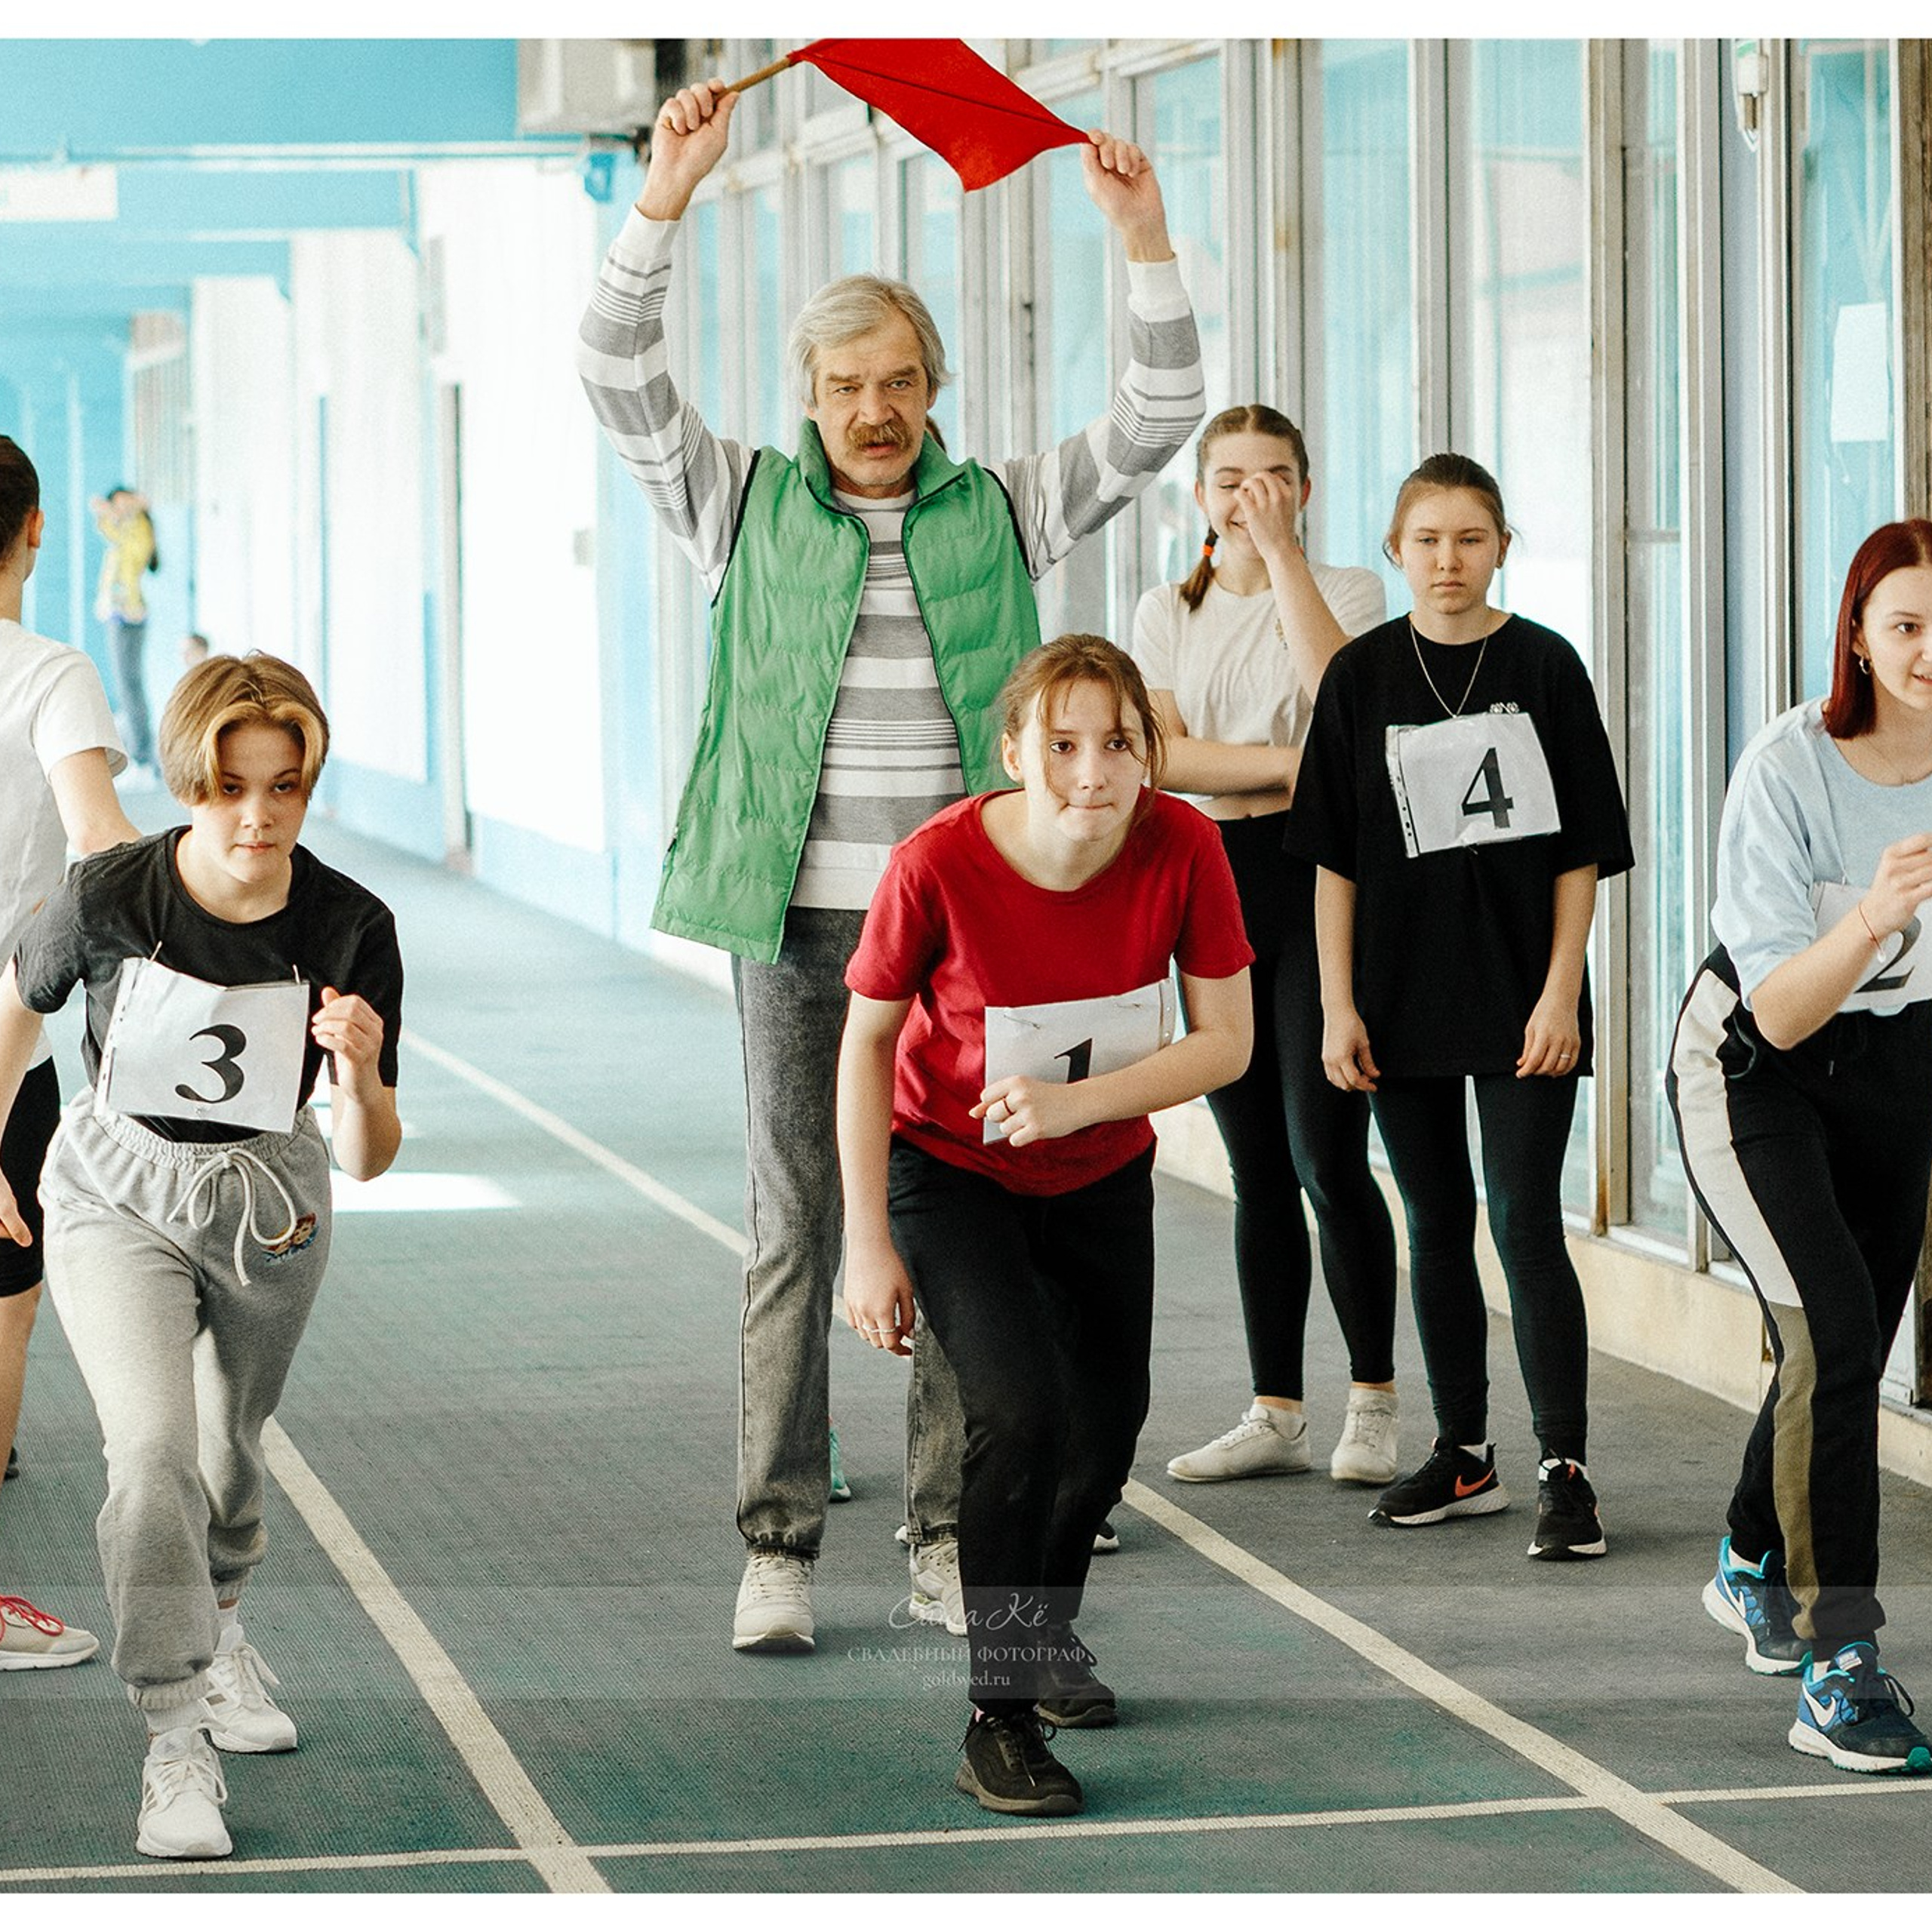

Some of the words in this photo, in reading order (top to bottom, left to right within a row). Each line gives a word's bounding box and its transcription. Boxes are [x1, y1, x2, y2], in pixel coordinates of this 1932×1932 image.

[1461, 746, 1514, 829] 4
[1854, 915, 1922, 994] 2
[174, 1024, 248, 1103] 3
